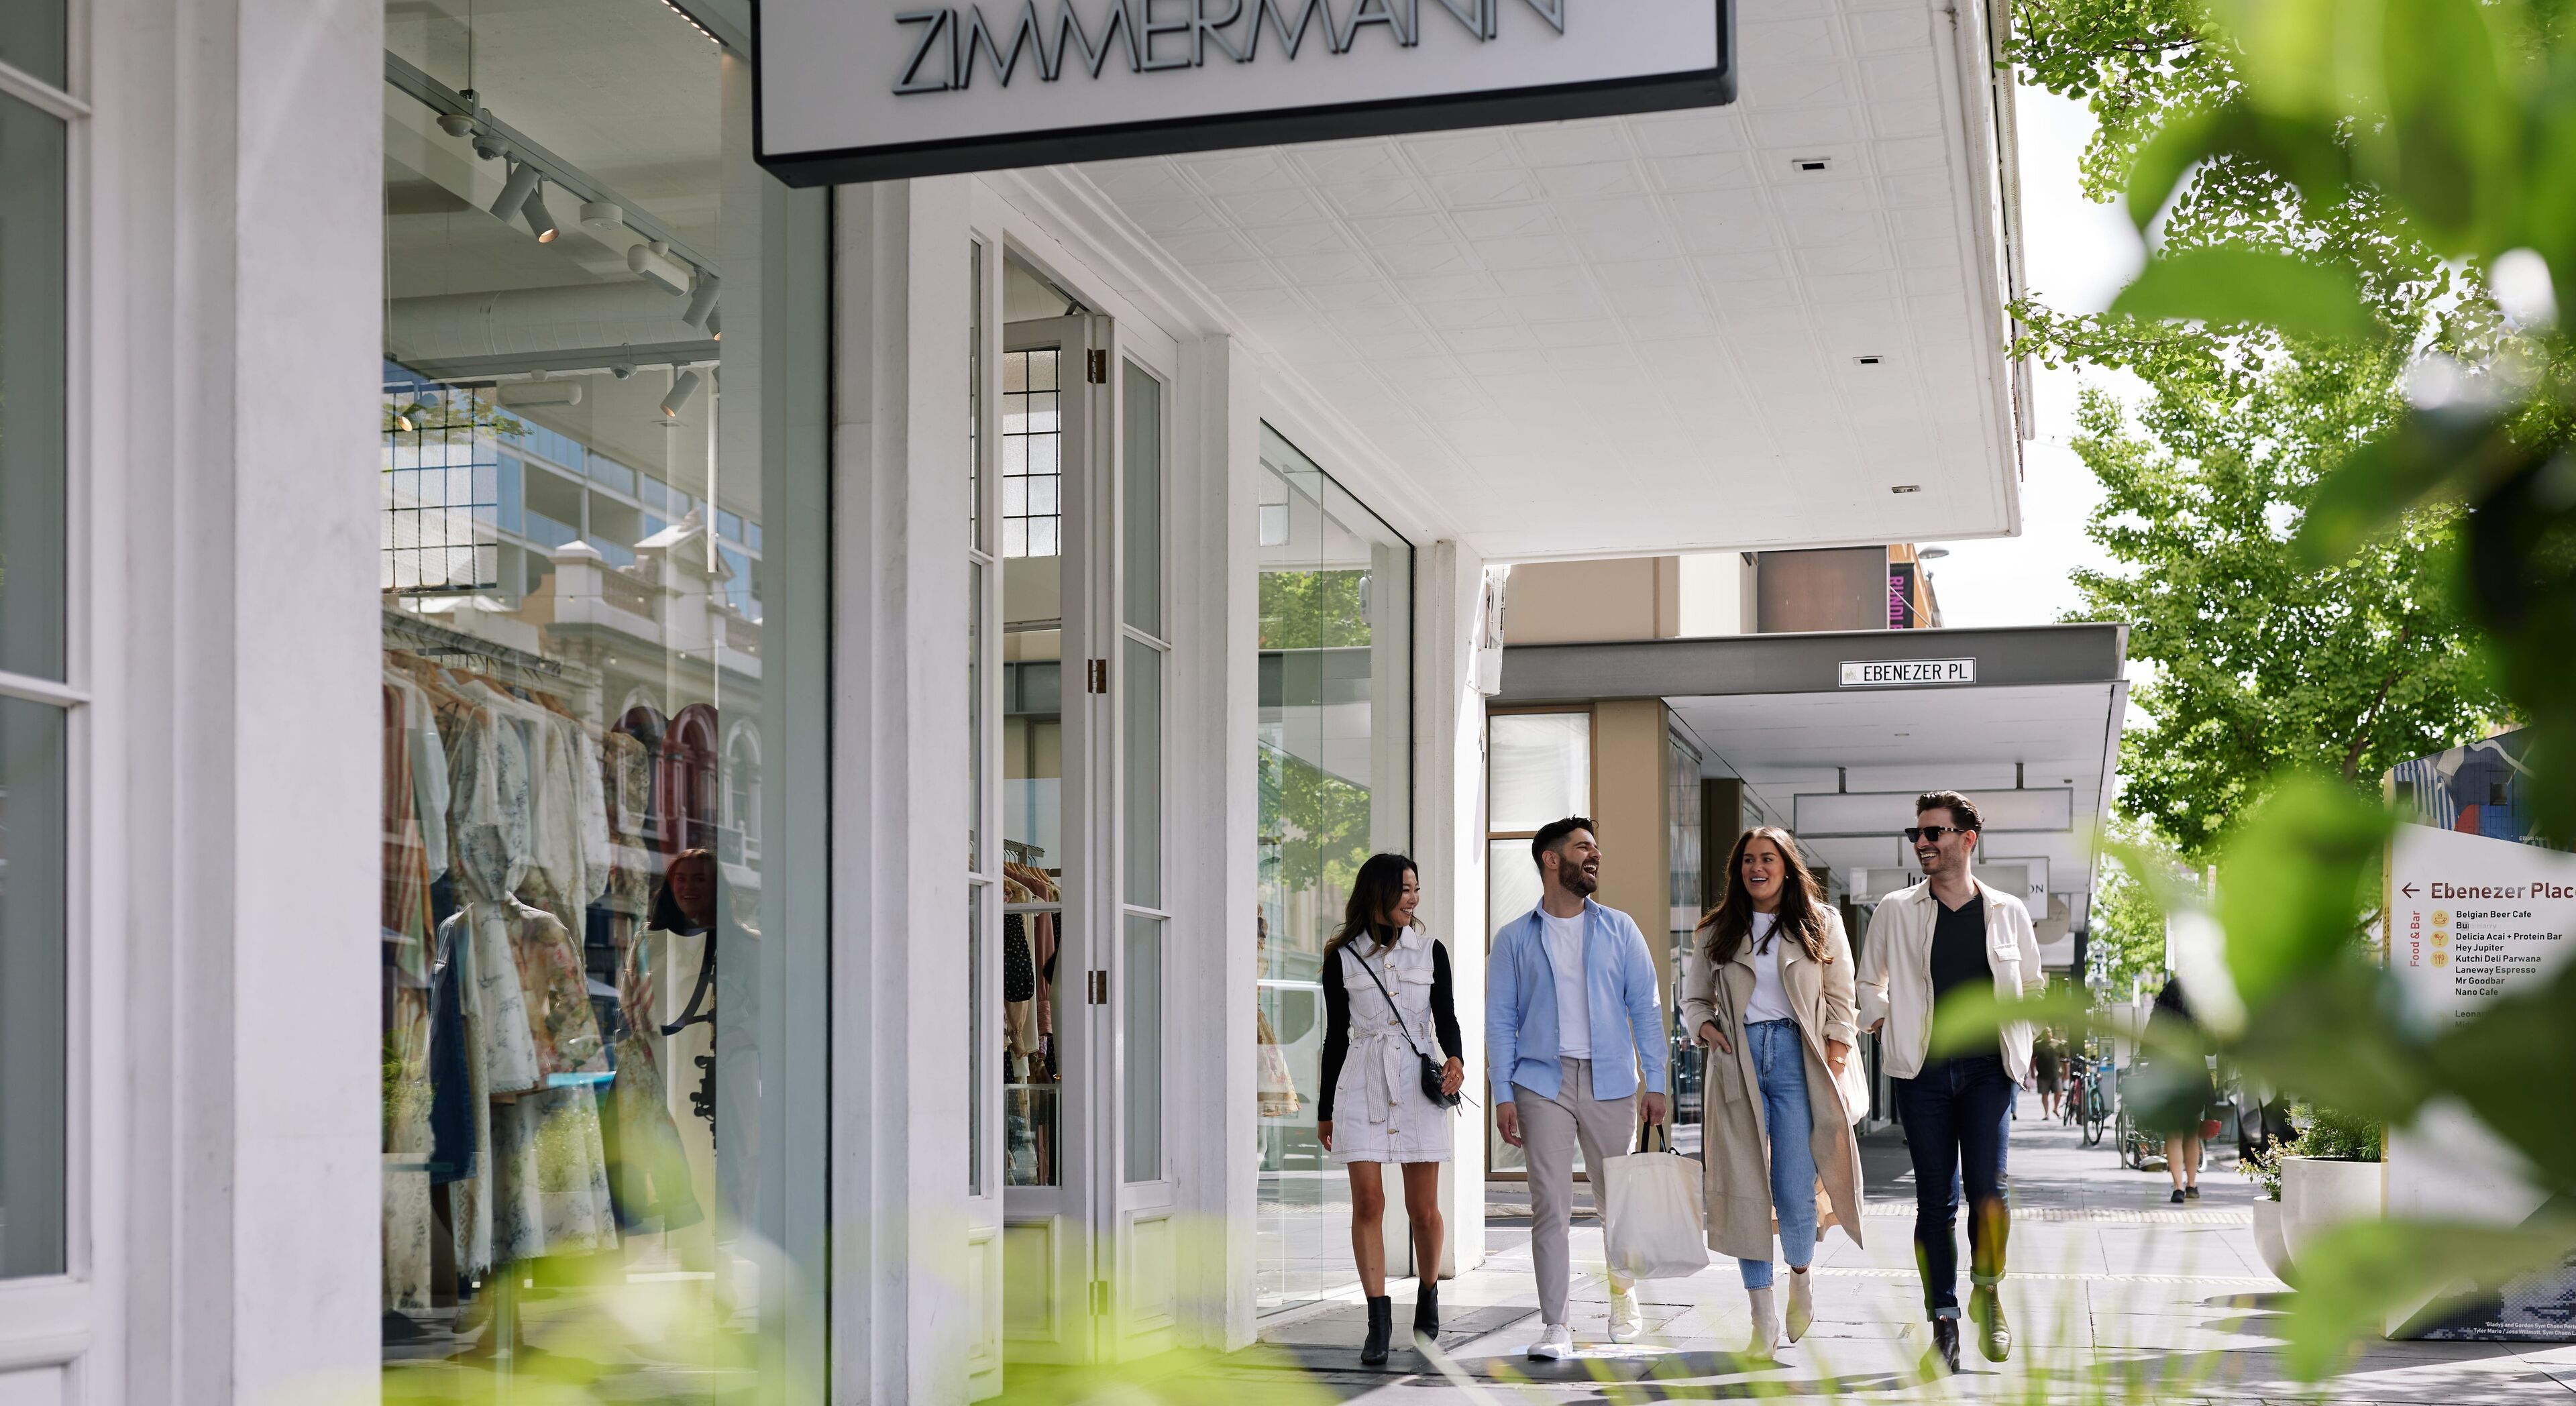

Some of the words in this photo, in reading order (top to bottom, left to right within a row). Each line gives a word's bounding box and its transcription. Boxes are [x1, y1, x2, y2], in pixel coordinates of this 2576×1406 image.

[1864, 663, 1941, 682] EBENEZER
[1949, 663, 1968, 679] PL
[2431, 882, 2526, 900] Ebenezer
[2530, 882, 2576, 899] Plac
[2410, 910, 2420, 929] Bar
[2457, 910, 2488, 920] Belgian
[2490, 910, 2511, 918] Beer
[2512, 910, 2532, 918] Cafe
[2410, 932, 2420, 940] &
[2456, 932, 2485, 940] Delicia
[2486, 932, 2506, 940] Acai
[2514, 932, 2545, 940] Protein
[2547, 932, 2563, 940] Bar
[2456, 944, 2472, 953] Hey
[2473, 944, 2504, 953] Jupiter
[2410, 942, 2420, 967] Food
[2455, 955, 2483, 963] Kutchi
[2485, 955, 2502, 963] Deli
[2503, 955, 2541, 963] Parwana
[2455, 966, 2494, 975] Laneway
[2496, 966, 2536, 975] Espresso
[2455, 977, 2467, 985] Mr
[2469, 977, 2506, 985] Goodbar
